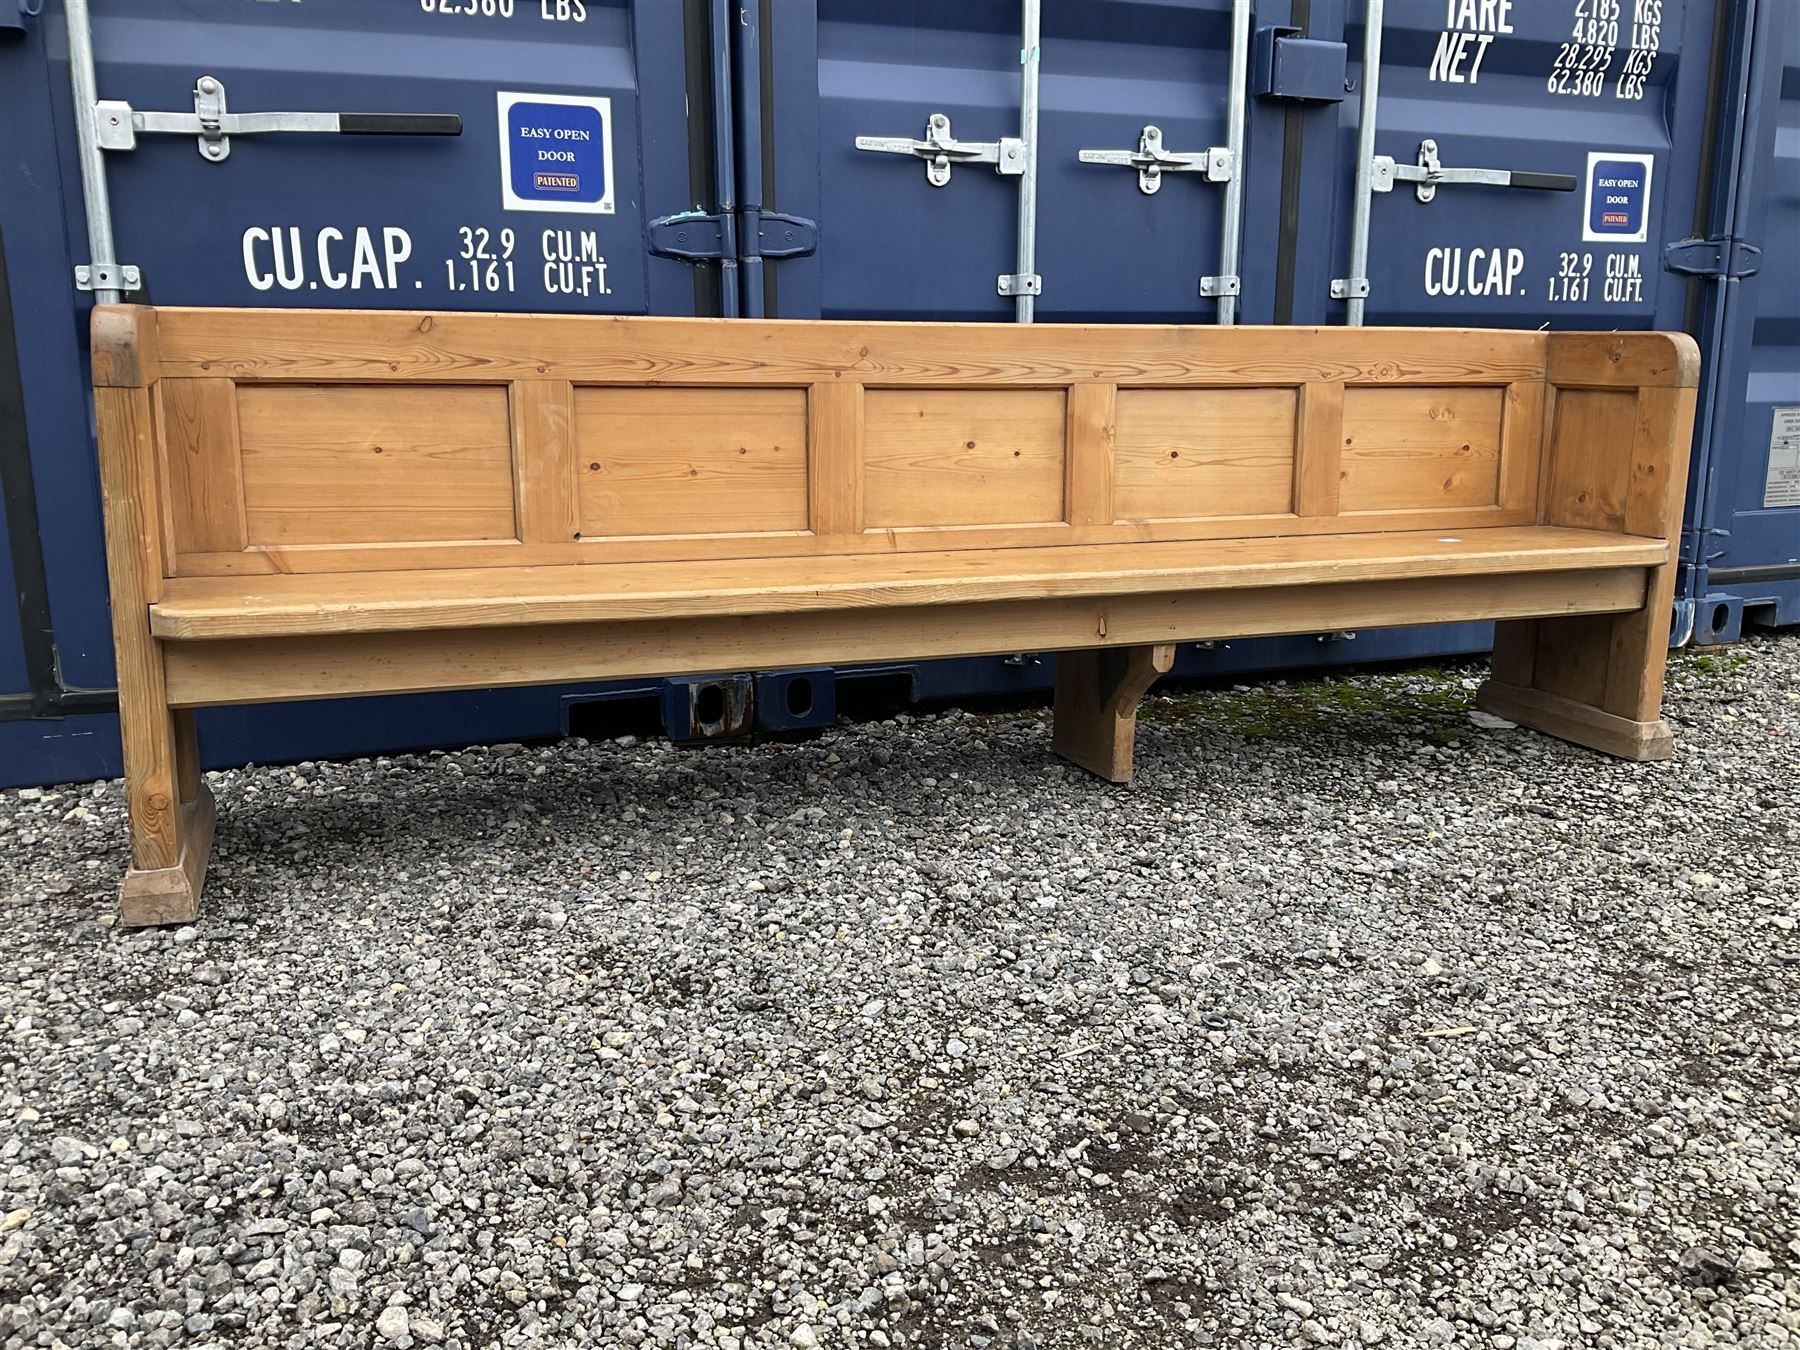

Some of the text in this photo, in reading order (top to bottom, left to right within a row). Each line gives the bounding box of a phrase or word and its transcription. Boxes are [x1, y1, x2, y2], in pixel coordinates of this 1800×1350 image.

[541, 0, 587, 22] LBS
[1633, 0, 1662, 25] KGS
[1632, 24, 1660, 50] LBS
[1430, 31, 1494, 83] NET
[1623, 49, 1657, 75] KGS
[1616, 74, 1647, 100] LBS
[520, 127, 590, 141] EASY OPEN
[537, 150, 576, 162] DOOR
[537, 176, 577, 187] PATENTED
[1598, 178, 1639, 188] EASY OPEN
[1606, 195, 1629, 204] DOOR
[459, 226, 605, 263] 32.9 CU.M.
[243, 226, 422, 290] CU.CAP.
[1558, 252, 1642, 278] 32.9 CU.M.
[446, 259, 612, 297] 1,161 CU.FT.
[1424, 247, 1526, 296] CU.CAP.
[1549, 276, 1643, 302] 1,161 CU.FT.
